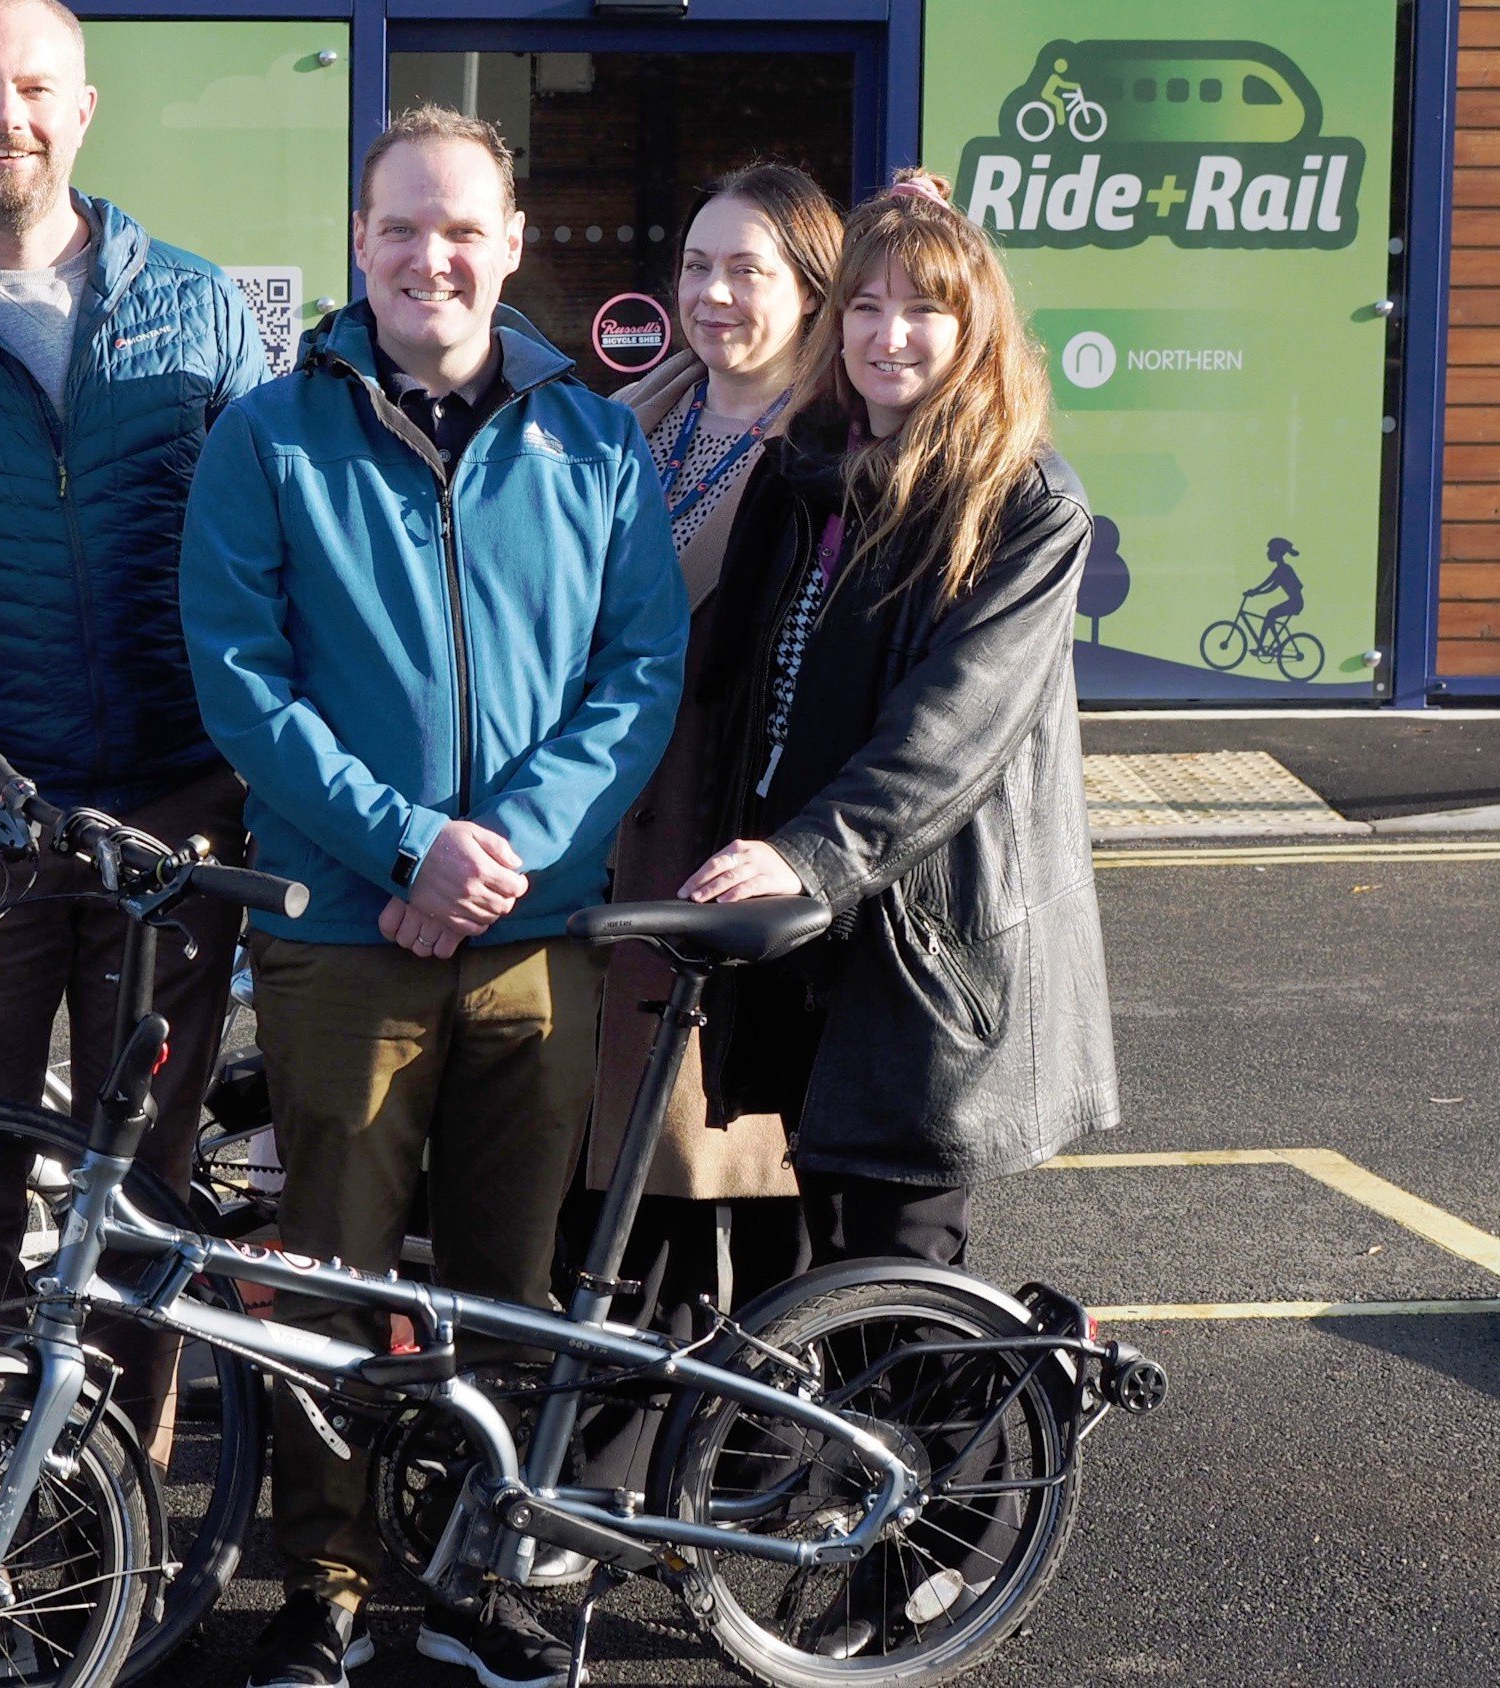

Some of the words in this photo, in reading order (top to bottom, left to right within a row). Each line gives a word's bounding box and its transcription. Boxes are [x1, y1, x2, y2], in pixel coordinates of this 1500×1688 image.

[126, 325, 173, 346] MONTANE
[601, 319, 661, 334] Russell's
[602, 336, 637, 345] BICYCLE
[638, 336, 661, 344] SHED
[1127, 349, 1243, 371] NORTHERN
